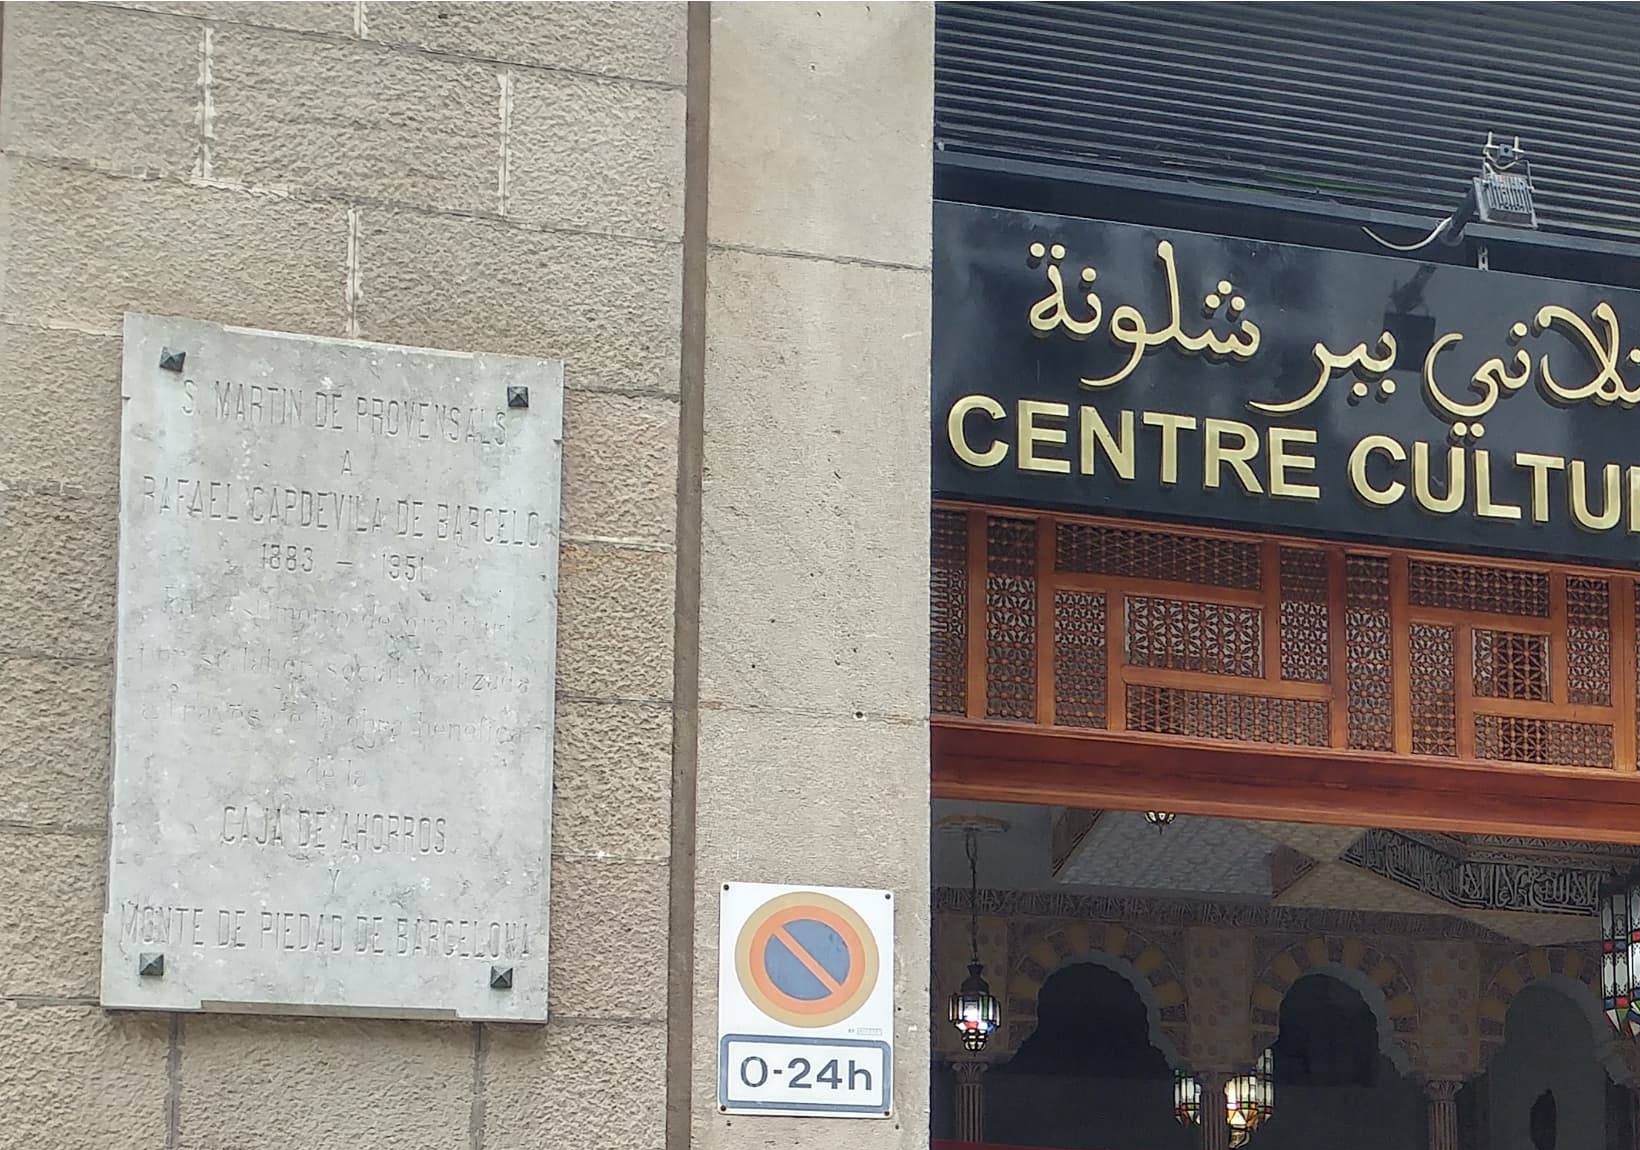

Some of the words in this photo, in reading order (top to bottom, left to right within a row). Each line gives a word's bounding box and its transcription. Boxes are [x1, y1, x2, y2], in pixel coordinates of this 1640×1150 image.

[215, 380, 304, 427] MARTIN
[315, 392, 344, 431] DE
[357, 396, 508, 446] PROVENSALS
[340, 450, 353, 475] A
[948, 395, 1320, 498] CENTRE
[142, 475, 241, 521] RAFAEL
[250, 486, 383, 533] CAPDEVILA
[396, 500, 424, 539] DE
[436, 504, 541, 548] BARCELO
[260, 543, 315, 573] 1883
[382, 553, 425, 581] 1951
[221, 805, 284, 847] CAJA
[298, 809, 326, 848] DE
[340, 812, 448, 855] AHORROS
[328, 868, 342, 894] Y
[120, 904, 204, 946] MONTE
[217, 909, 247, 949] DE
[260, 912, 344, 953] PIEDAD
[354, 916, 384, 955] DE
[397, 917, 529, 960] BARCELONA
[739, 1055, 873, 1091] 0-24h
